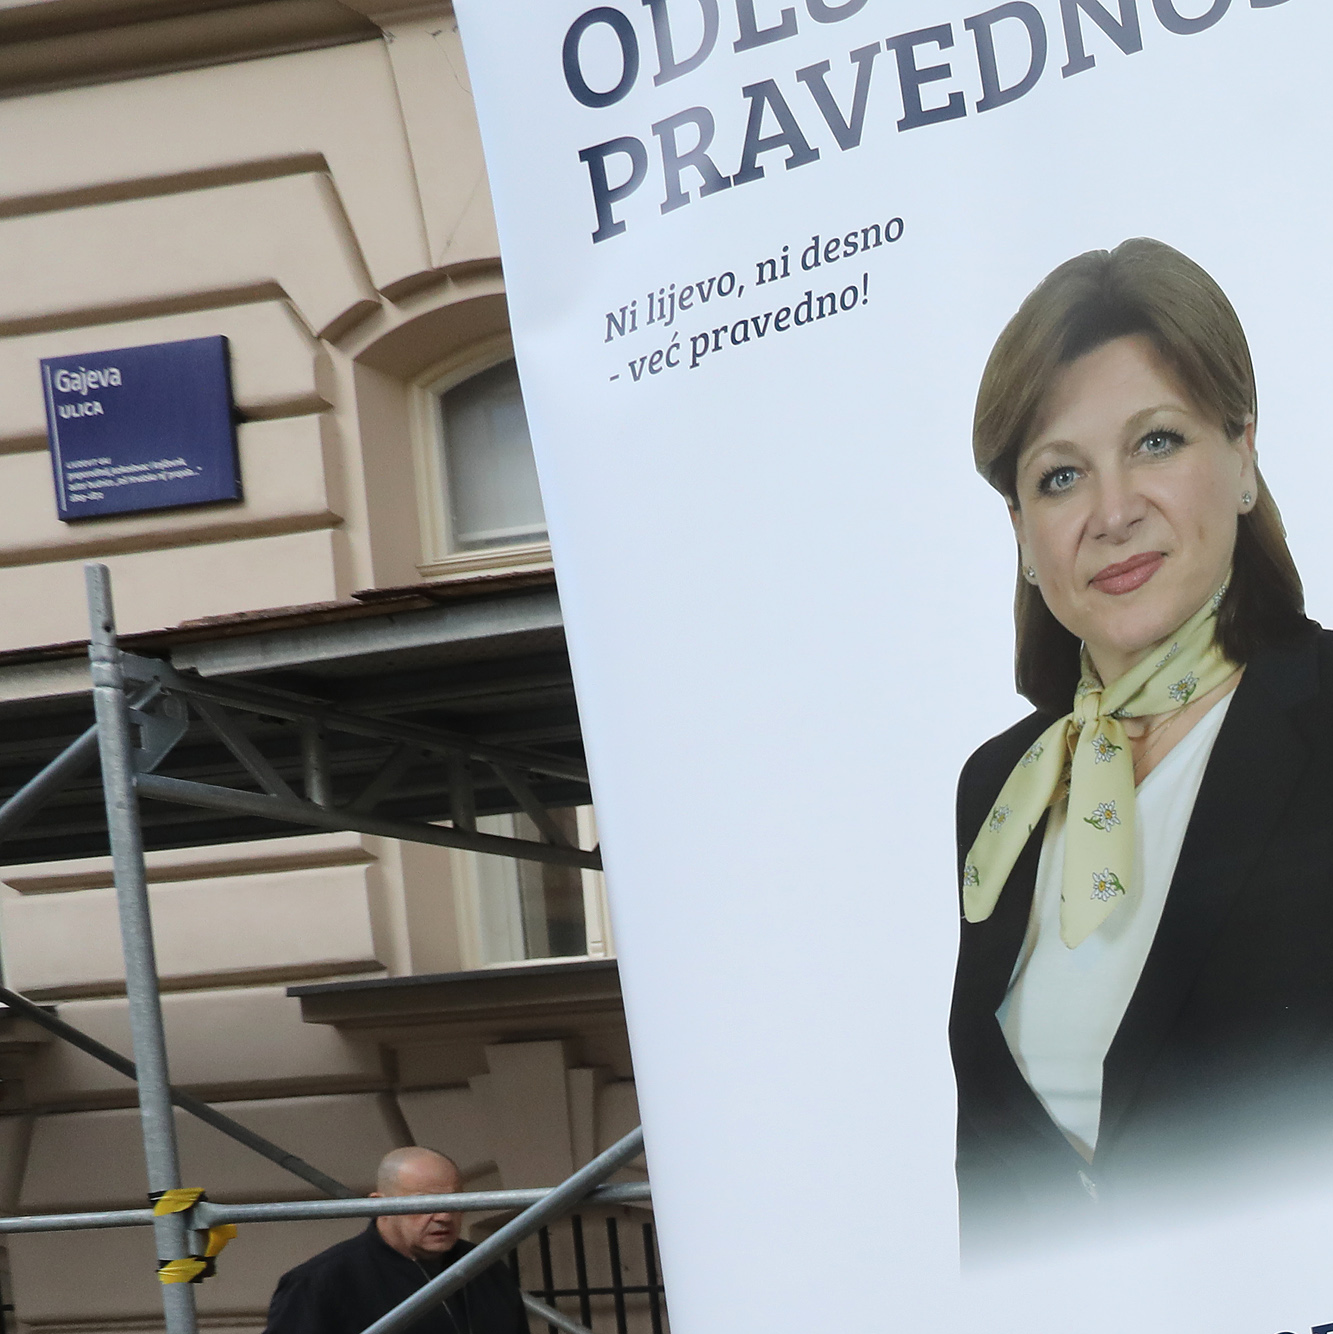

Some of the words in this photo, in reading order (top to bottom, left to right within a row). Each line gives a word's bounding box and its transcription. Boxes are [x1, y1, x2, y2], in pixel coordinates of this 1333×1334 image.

[561, 0, 868, 109] ODL
[577, 0, 1292, 245] PRAVEDN
[604, 300, 638, 343] Ni
[646, 270, 745, 327] lijevo,
[755, 245, 790, 286] ni
[801, 216, 905, 271] desno
[628, 331, 681, 382] već
[689, 272, 869, 370] pravedno!
[54, 366, 123, 396] Gajeva
[58, 400, 105, 420] ULICA
